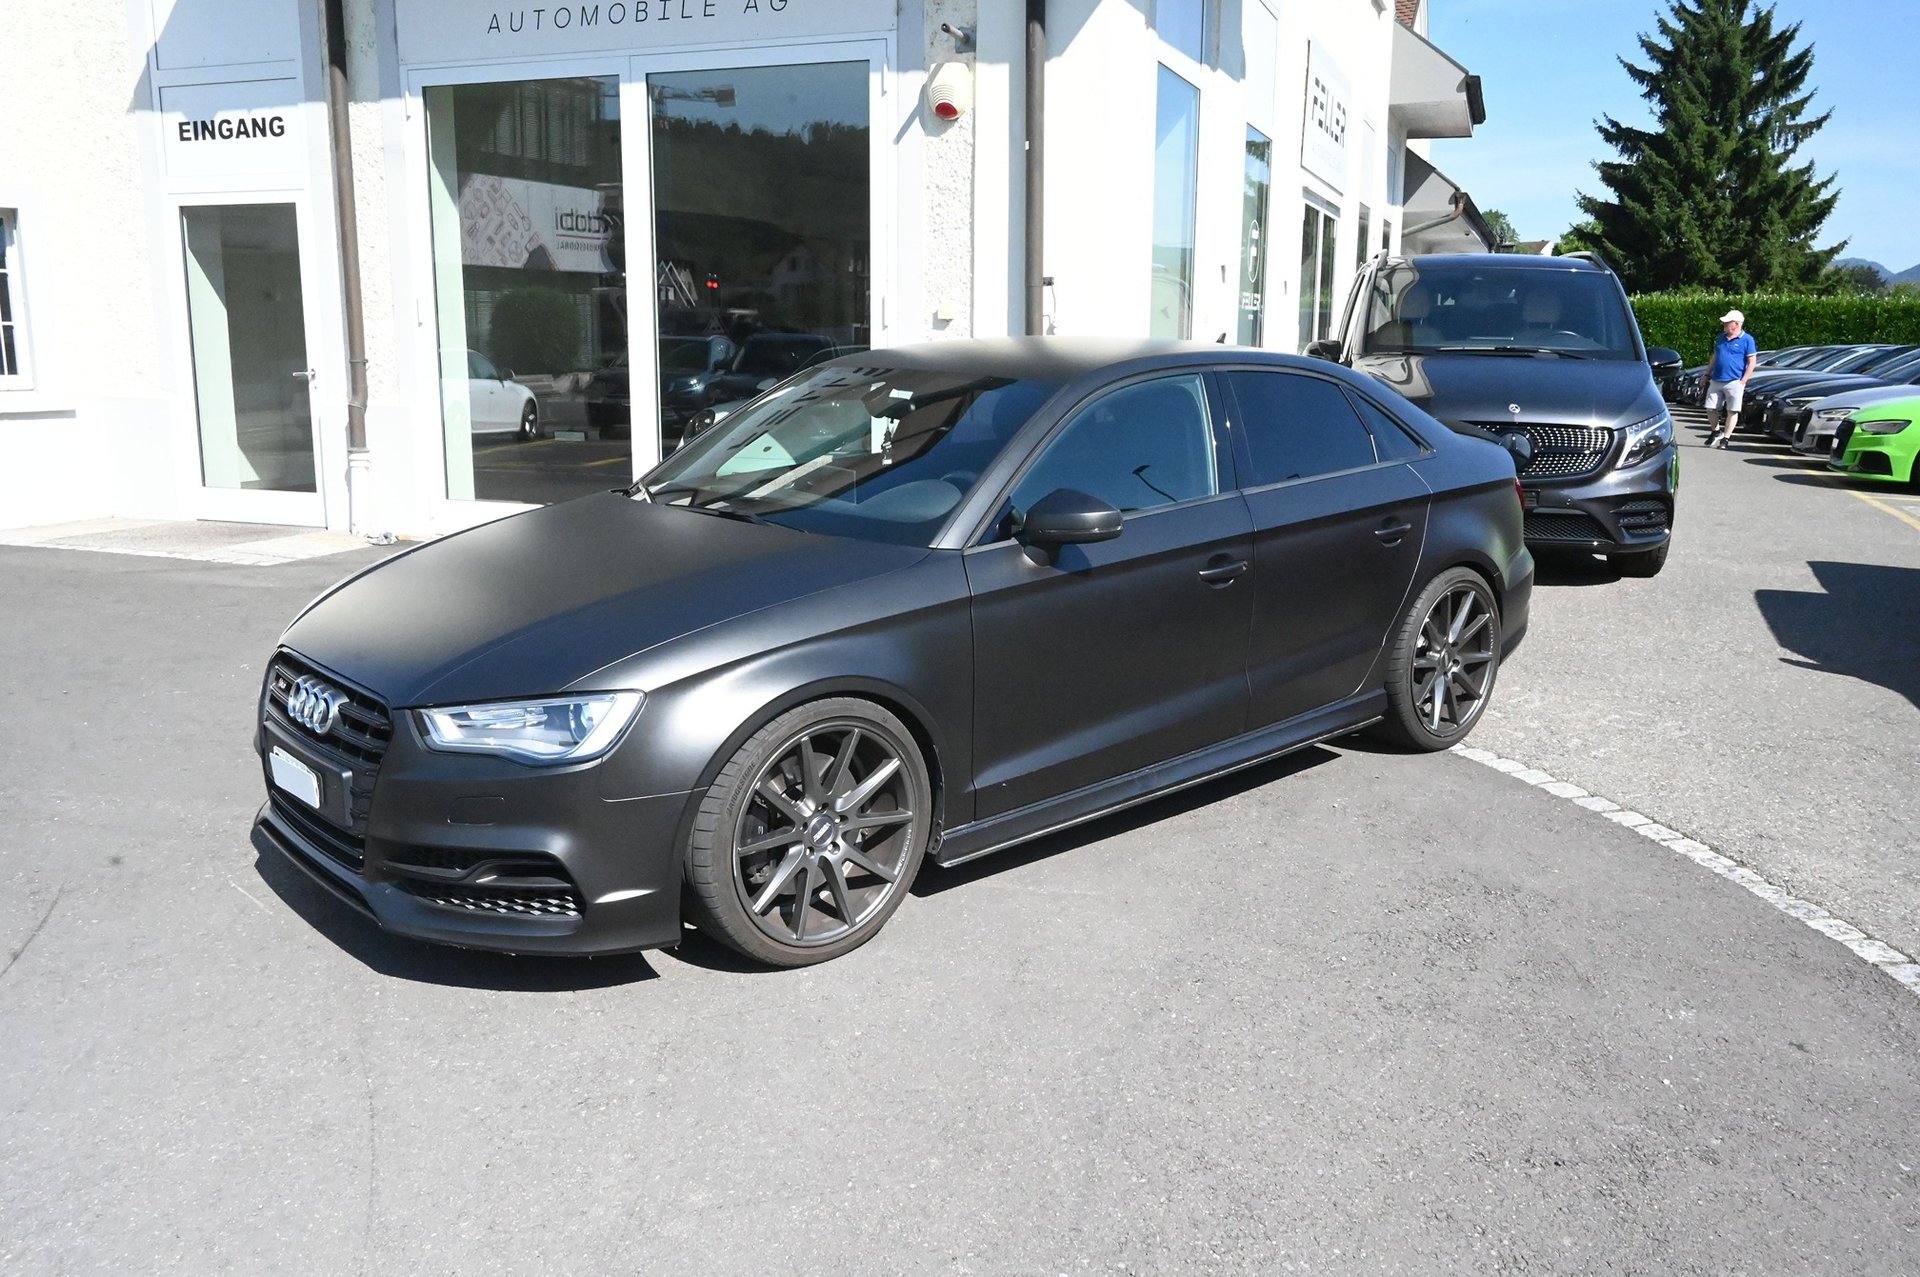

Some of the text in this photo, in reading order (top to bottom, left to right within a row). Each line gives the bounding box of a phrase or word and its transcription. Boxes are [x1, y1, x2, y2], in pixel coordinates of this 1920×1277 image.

[487, 0, 787, 34] AUTOMOBILE AG
[178, 116, 285, 141] EINGANG
